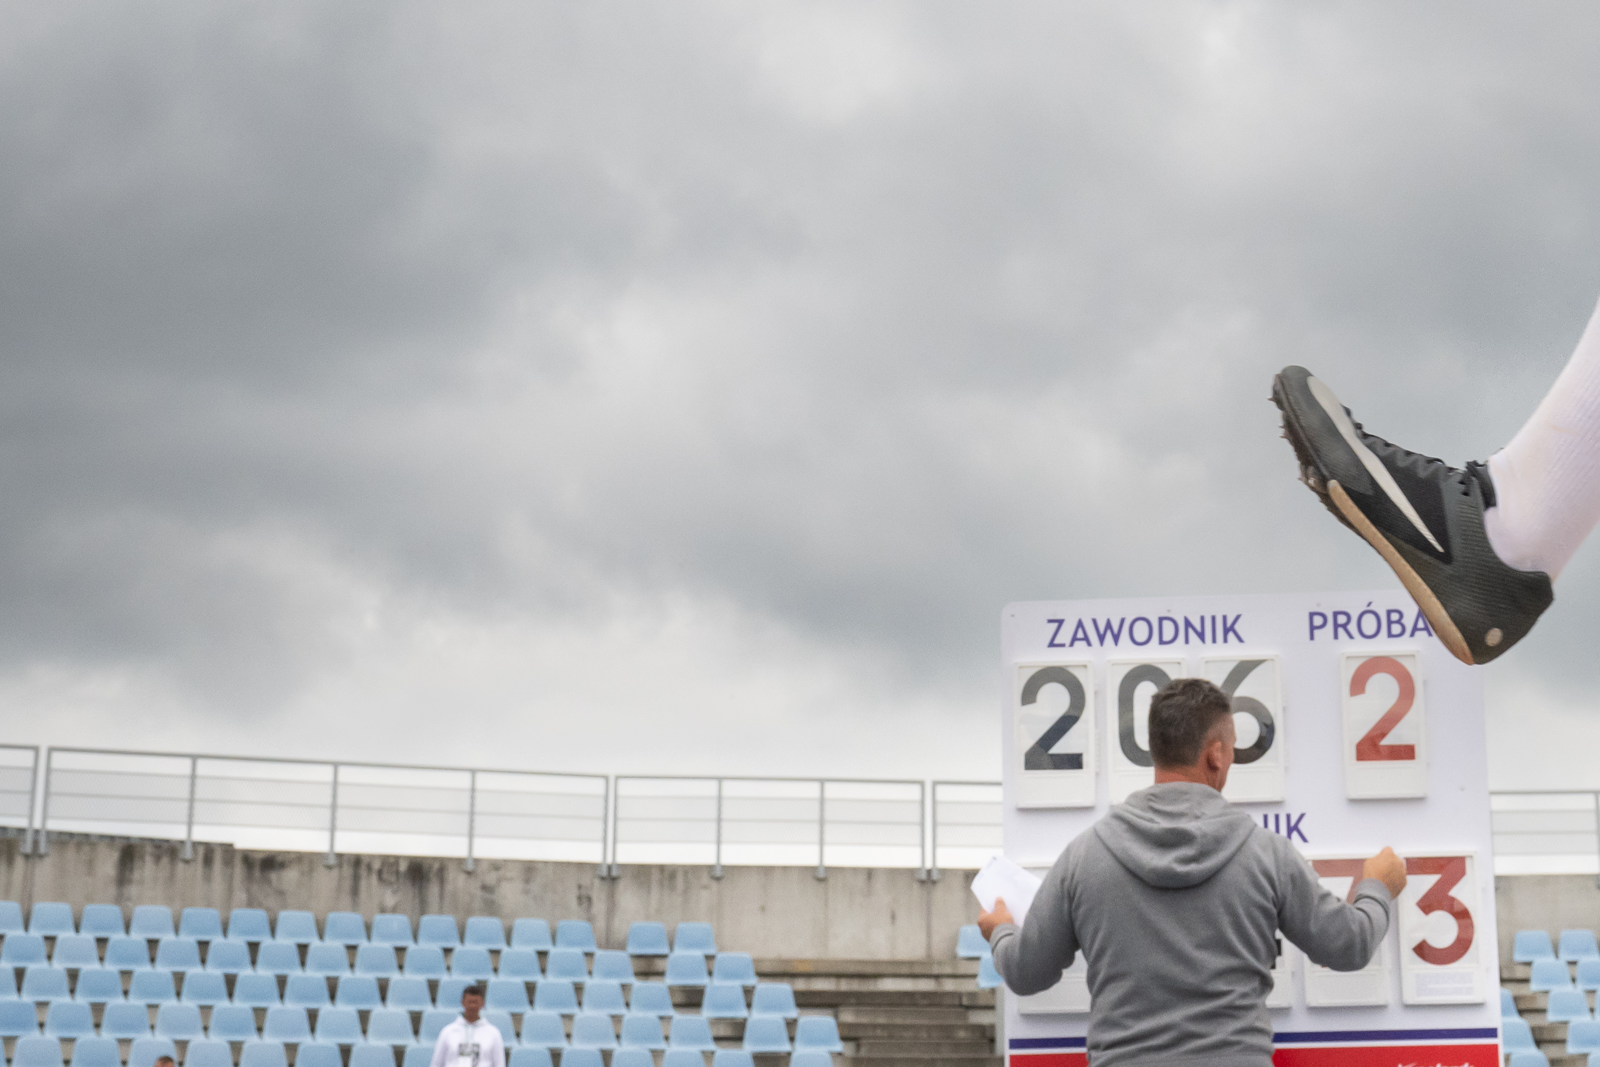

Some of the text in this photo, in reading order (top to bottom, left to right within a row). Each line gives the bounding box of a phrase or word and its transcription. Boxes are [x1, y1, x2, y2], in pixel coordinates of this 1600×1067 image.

[1046, 602, 1433, 649] ZAWODNIK PRÓBA
[1349, 656, 1416, 761] 2
